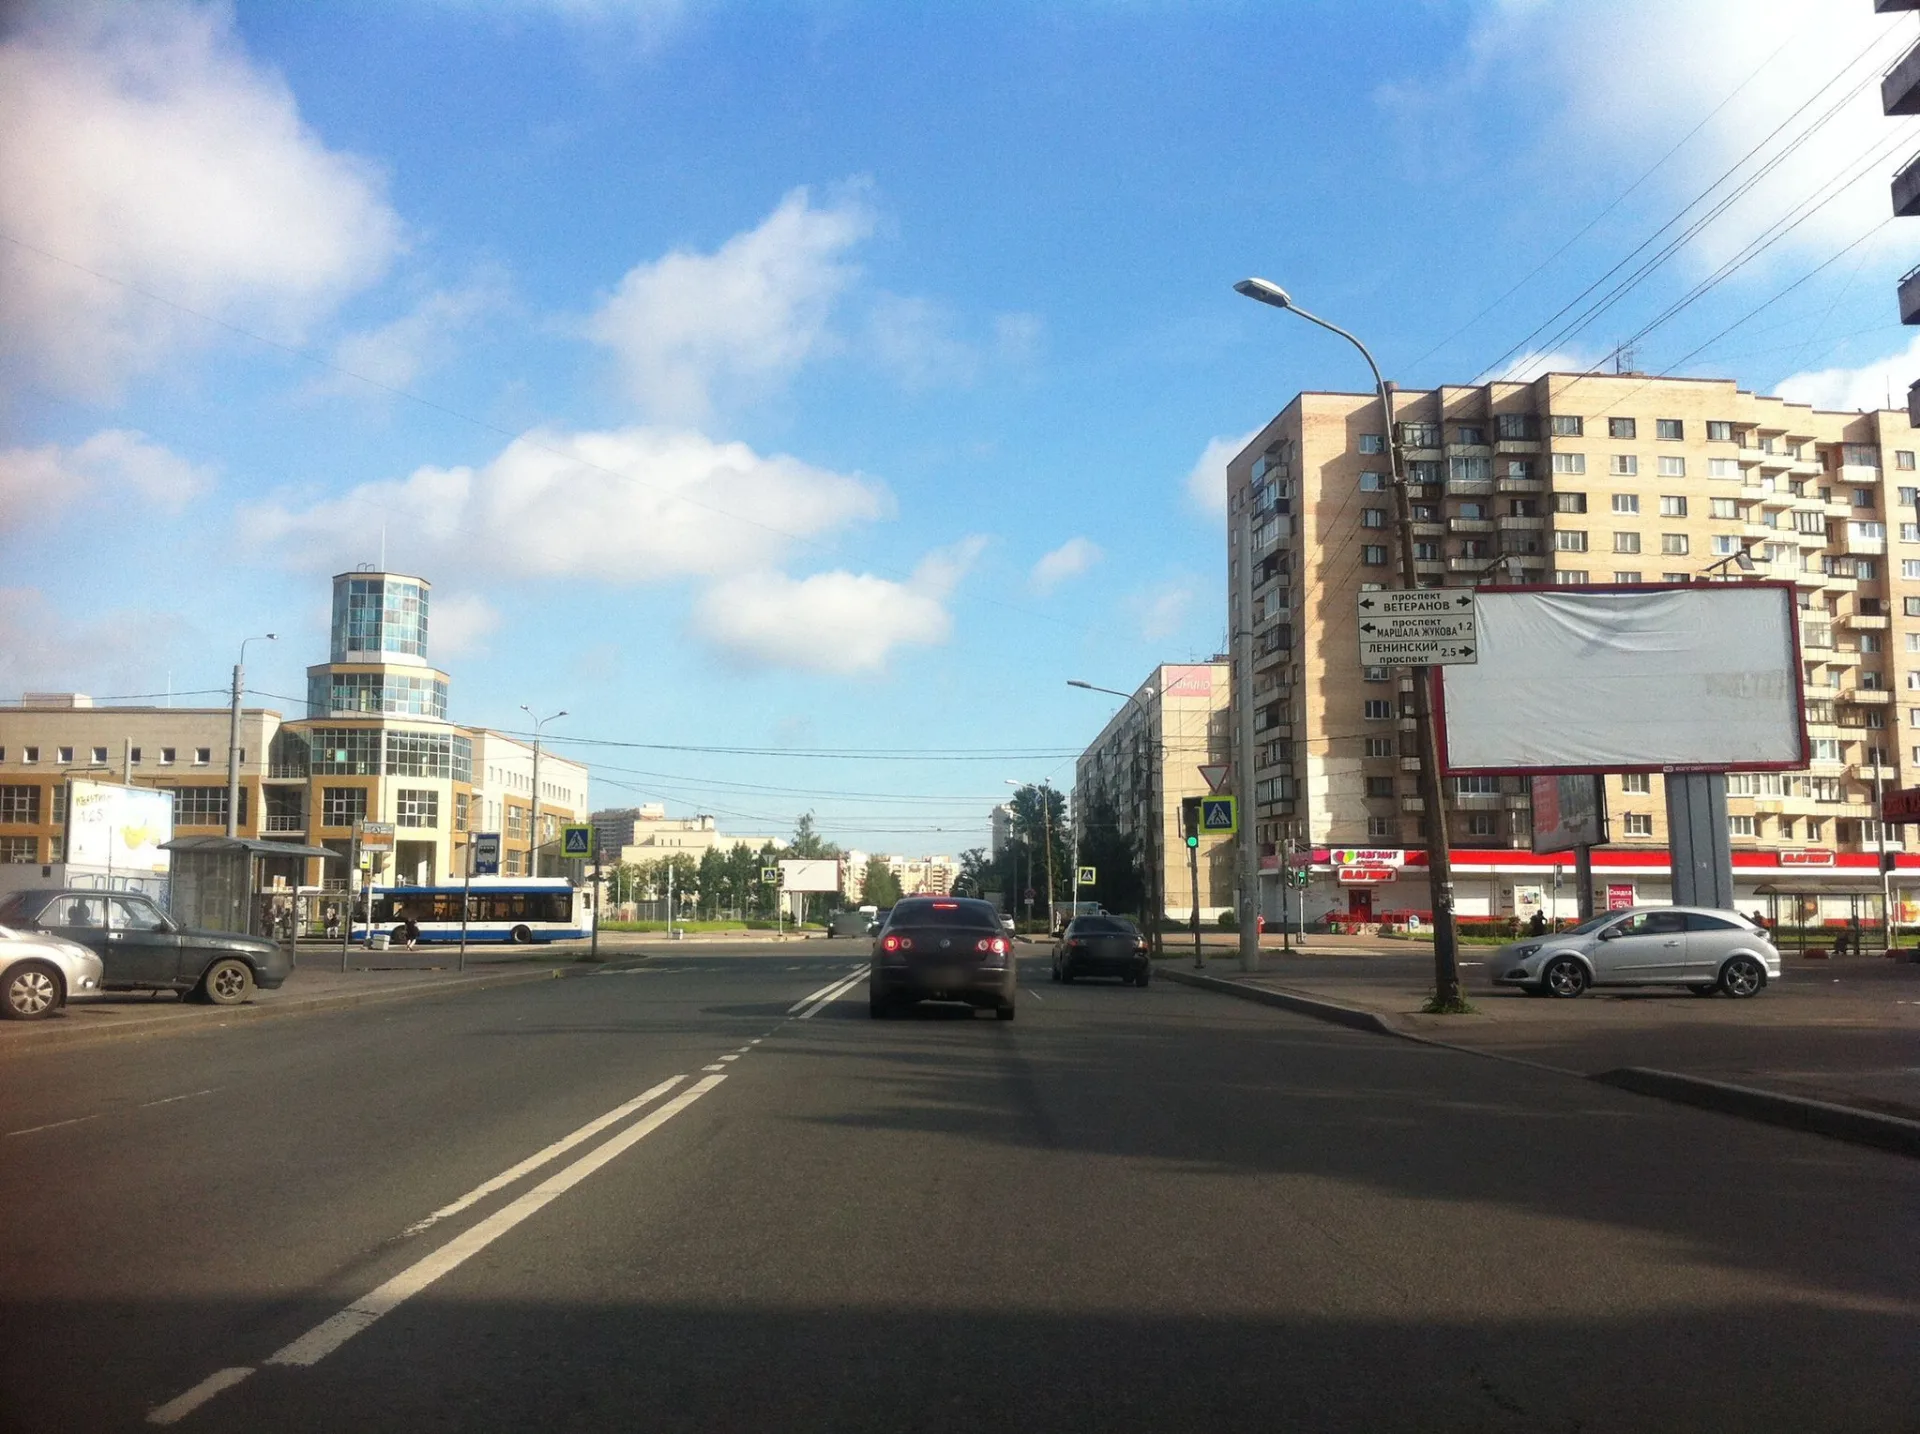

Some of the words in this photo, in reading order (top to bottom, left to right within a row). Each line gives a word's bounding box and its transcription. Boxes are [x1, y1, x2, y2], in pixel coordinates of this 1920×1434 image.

[1392, 592, 1441, 602] проспект
[1384, 601, 1450, 612] ВЕТЕРАНОВ
[1392, 619, 1441, 628] проспект
[1458, 622, 1473, 631] 1.2
[1377, 628, 1419, 638] МАРШАЛА
[1422, 626, 1458, 637] ЖУКОВА
[1369, 641, 1438, 652] ЛЕНИНСКИЙ
[1441, 648, 1456, 657] 2.5
[1379, 655, 1429, 665] проспект
